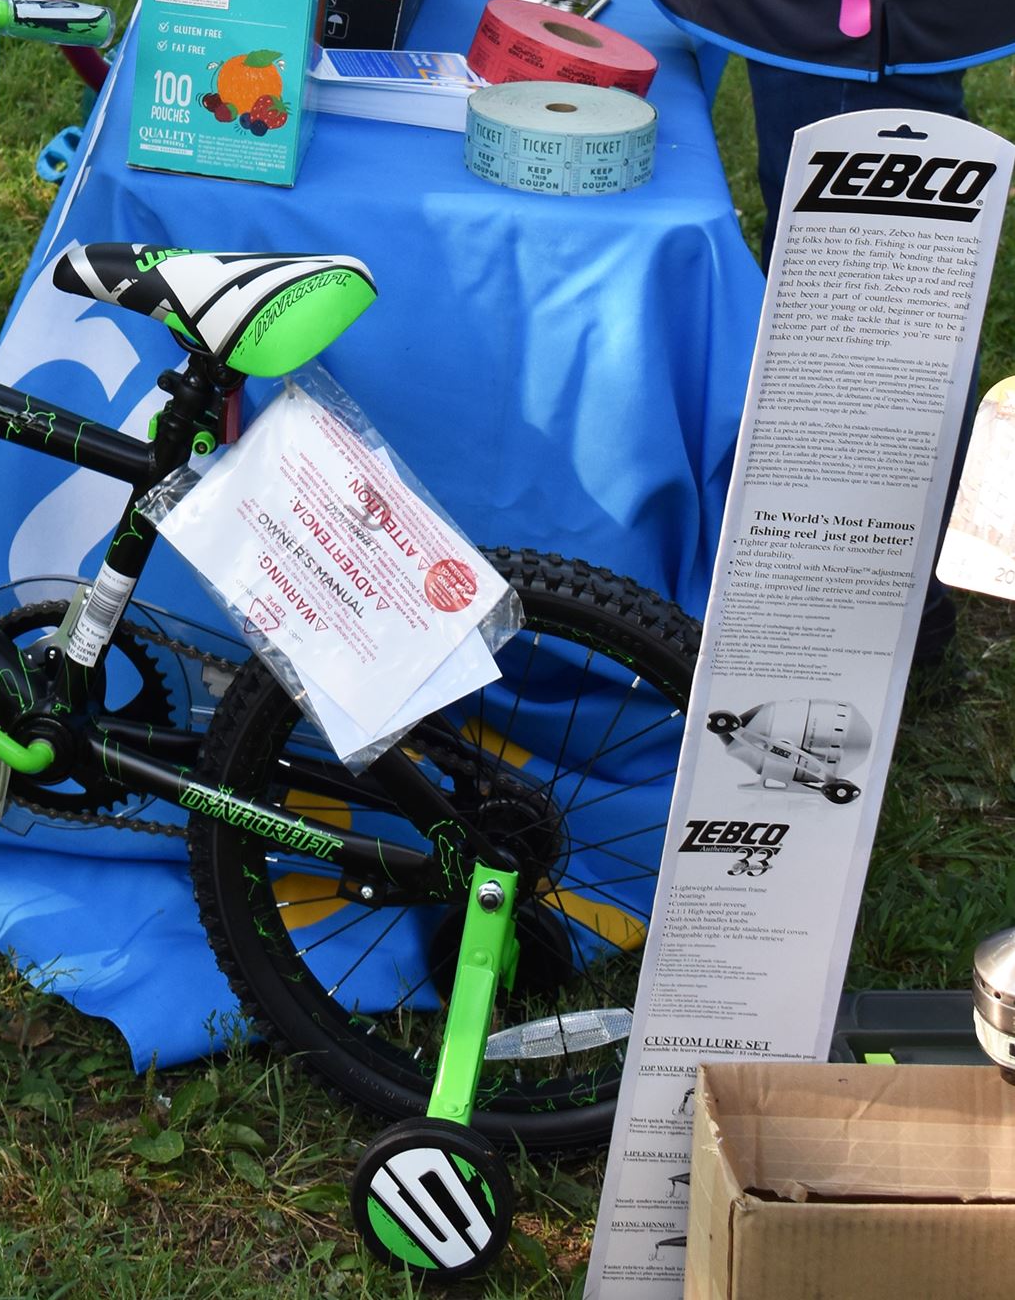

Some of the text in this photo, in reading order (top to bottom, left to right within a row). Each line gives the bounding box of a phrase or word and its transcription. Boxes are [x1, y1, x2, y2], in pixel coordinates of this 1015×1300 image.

[174, 25, 223, 39] GLUTEN FREE
[172, 43, 206, 56] FAT FREE
[154, 69, 193, 107] 100
[151, 105, 190, 124] POUCHES
[139, 126, 196, 145] QUALITY
[476, 123, 502, 145] TICKET
[523, 138, 562, 155] TICKET
[586, 140, 621, 155] TICKET
[478, 152, 495, 163] KEEP
[480, 160, 491, 168] THIS
[473, 163, 500, 179] COUPON
[527, 165, 552, 175] KEEP
[590, 167, 613, 175] KEEP
[519, 178, 559, 190] COUPON
[582, 181, 618, 189] COUPON
[793, 151, 997, 222] ZEBCO
[788, 224, 803, 232] For
[828, 225, 846, 233] than
[848, 226, 860, 234] 60
[861, 228, 886, 236] years,
[888, 228, 915, 237] Zebco
[917, 230, 931, 239] has
[934, 232, 954, 241] been
[956, 235, 981, 244] teach-
[786, 235, 800, 245] ing
[801, 235, 822, 243] folks
[823, 235, 842, 244] how
[854, 237, 872, 245] fish.
[874, 238, 905, 250] Fishing
[907, 240, 914, 249] is
[932, 244, 964, 253] passion
[966, 246, 979, 255] be-
[825, 247, 849, 255] know
[852, 248, 865, 256] the
[868, 249, 896, 260] family
[899, 251, 933, 263] bonding
[936, 254, 952, 263] that
[956, 257, 977, 266] takes
[782, 257, 804, 266] place
[817, 259, 840, 268] every
[842, 258, 870, 269] fishing
[872, 260, 889, 271] trip.
[892, 261, 905, 270] We
[906, 263, 930, 272] know
[931, 265, 945, 274] the
[946, 266, 975, 279] feeling
[253, 271, 352, 346] DYNACRAFT
[348, 477, 419, 559] ATTENTION
[753, 510, 915, 531] The World's Most Famous
[749, 525, 913, 546] fishing reel just got better!
[286, 494, 377, 600] ADVERTENCIA:
[736, 548, 794, 560] and durability.
[739, 537, 902, 556] Tighter gear tolerances for smoother feel
[256, 511, 367, 619] OWNER'S MANUAL
[254, 550, 318, 623] WARNING:
[264, 593, 287, 618] LDPE
[179, 784, 345, 860] DYNACRAFT
[678, 820, 790, 855] ZEBCO
[700, 845, 736, 853] Authentic
[727, 847, 775, 877] 33
[644, 1036, 771, 1051] CUSTOM LURE SET
[640, 1065, 685, 1074] TOP WATER
[624, 1151, 690, 1160] LIPLESS RATTLE
